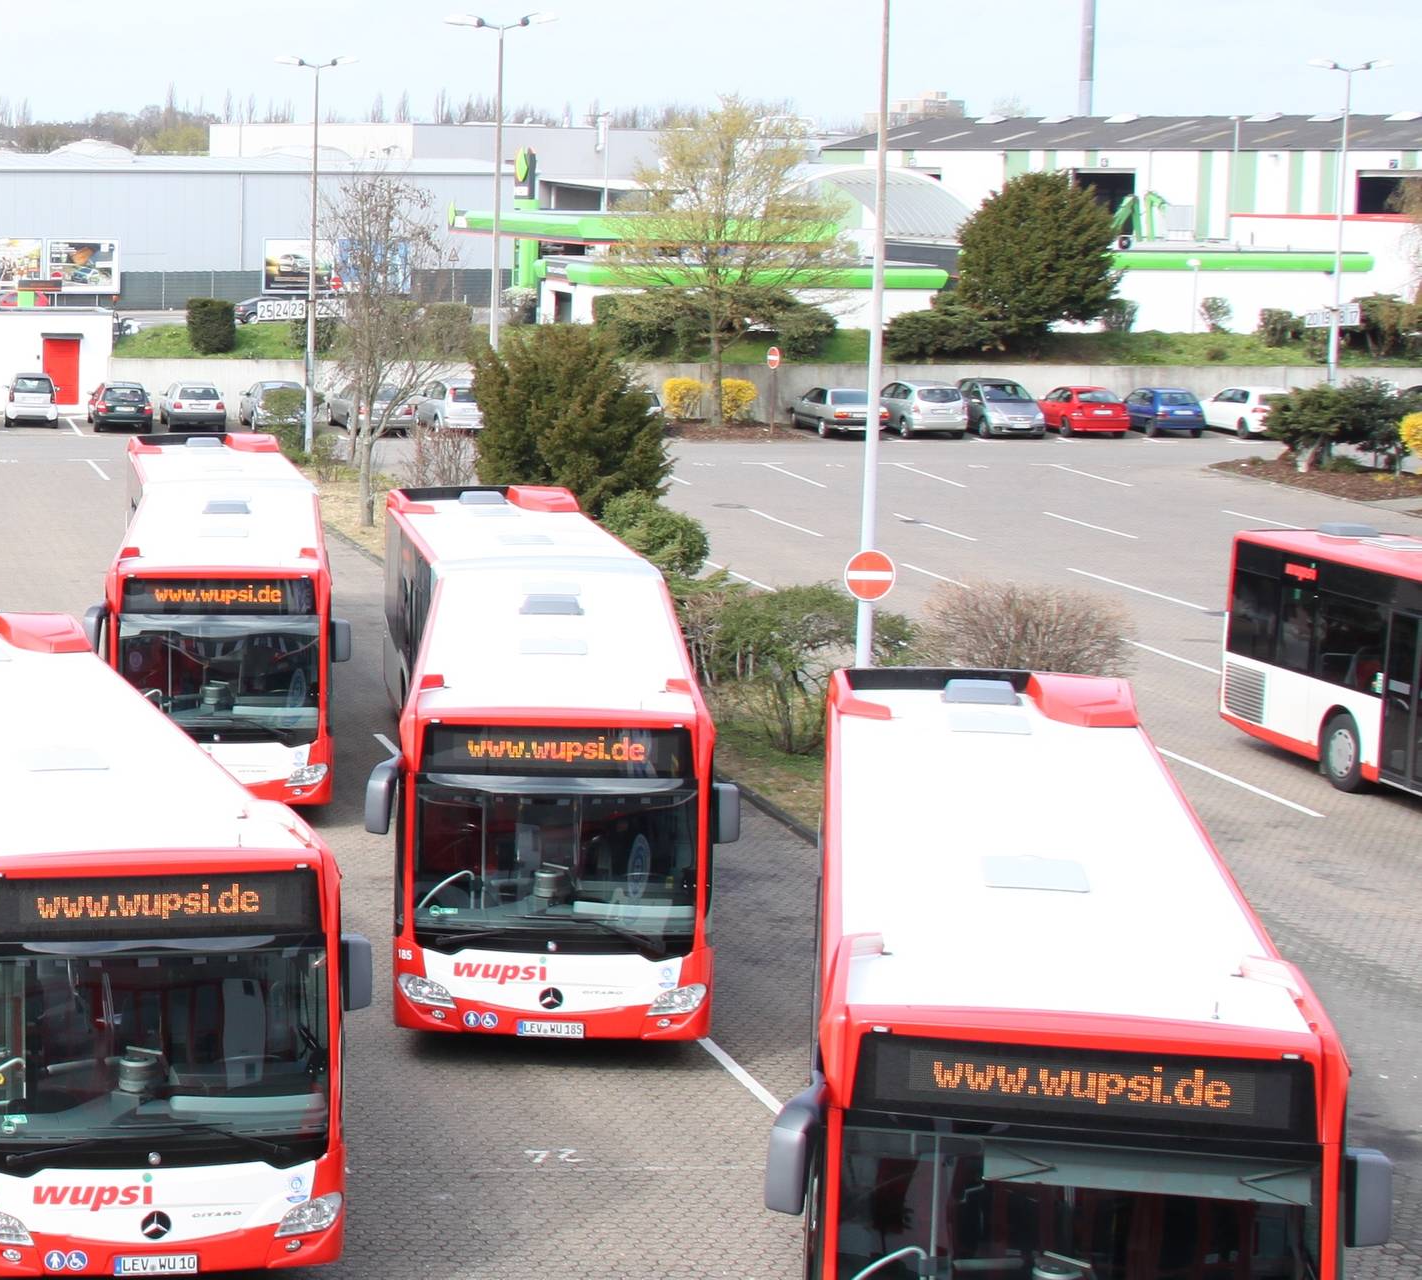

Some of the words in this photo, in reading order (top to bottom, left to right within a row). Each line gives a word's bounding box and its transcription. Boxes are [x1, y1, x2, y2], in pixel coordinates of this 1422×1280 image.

[259, 303, 274, 319] 25
[276, 303, 289, 317] 24
[291, 302, 305, 317] 23
[154, 584, 283, 605] www.wupsi.de
[467, 736, 646, 763] www.wupsi.de
[37, 883, 260, 920] www.wupsi.de
[398, 949, 413, 960] 185
[453, 956, 547, 985] wupsi
[524, 1022, 541, 1034] LEV
[550, 1023, 562, 1035] WU
[565, 1024, 582, 1035] 185
[932, 1060, 1232, 1109] www.wupsi.de
[33, 1173, 153, 1212] wupsi
[122, 1258, 147, 1272] LEV
[158, 1257, 176, 1271] WU
[178, 1256, 195, 1270] 10
